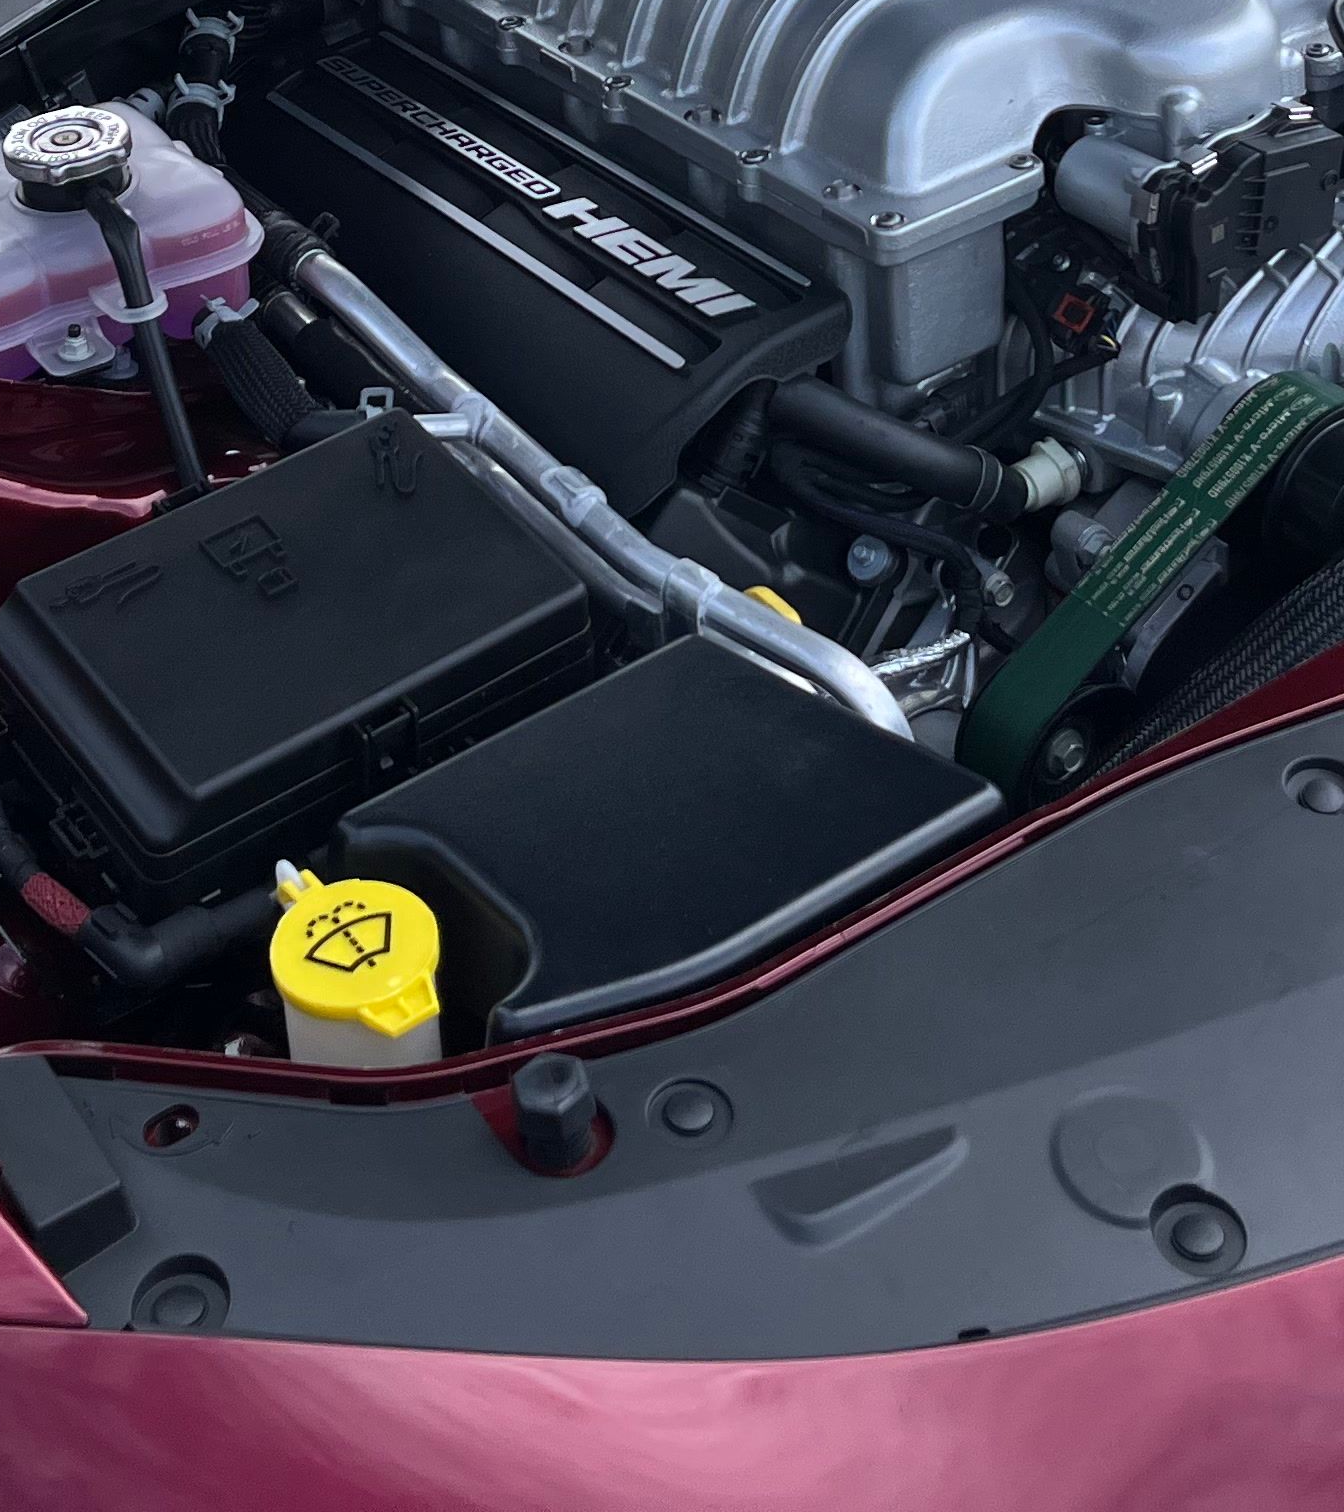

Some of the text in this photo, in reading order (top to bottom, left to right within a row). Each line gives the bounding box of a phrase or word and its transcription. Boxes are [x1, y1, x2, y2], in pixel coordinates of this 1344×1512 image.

[74, 110, 112, 121] KEEP
[318, 57, 756, 318] SUPERCHARGED HEMI
[1231, 397, 1276, 442] Micro-V
[1247, 407, 1291, 452] Micro-V
